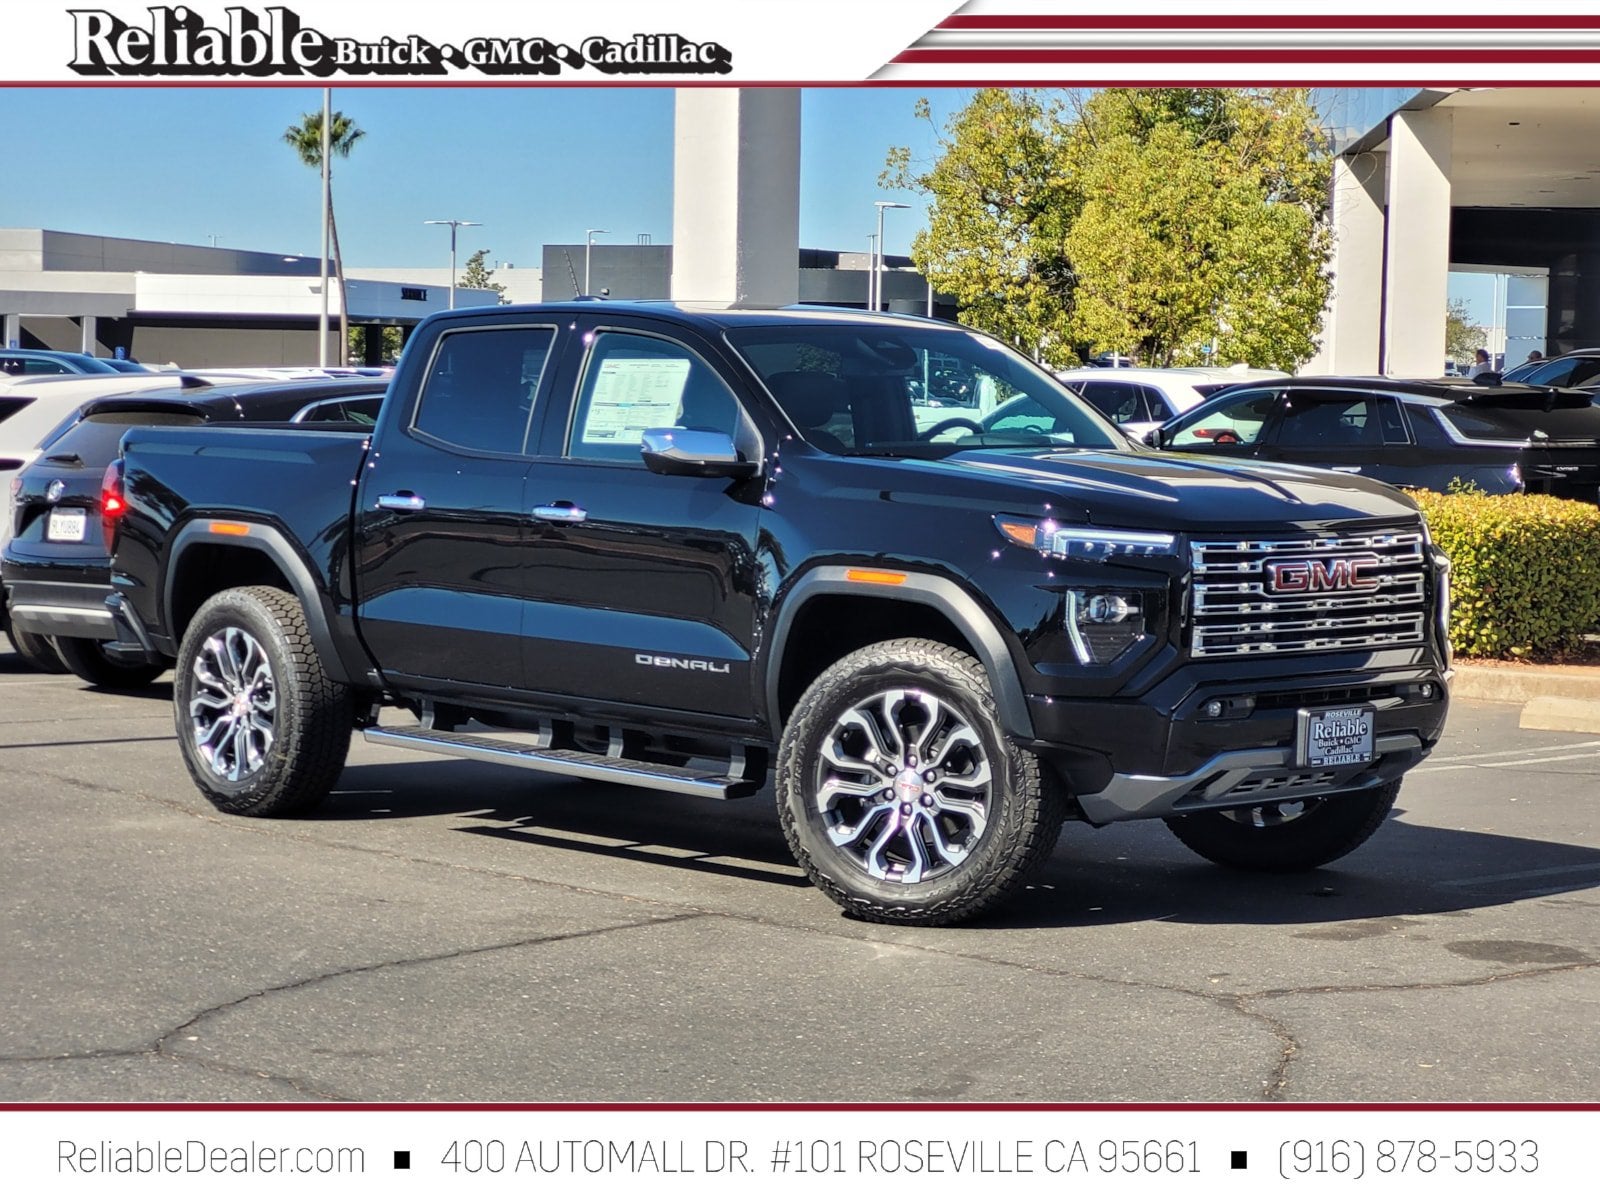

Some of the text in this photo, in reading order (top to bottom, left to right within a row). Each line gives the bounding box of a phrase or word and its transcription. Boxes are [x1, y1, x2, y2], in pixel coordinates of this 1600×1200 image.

[1274, 558, 1379, 592] GMC
[635, 653, 731, 674] DENALI
[1325, 709, 1360, 718] ROSEVILLE
[1314, 719, 1367, 739] Reliable
[1318, 737, 1361, 748] Buick GMC
[1324, 746, 1353, 755] Cadillac
[1323, 754, 1361, 765] RELIABLE
